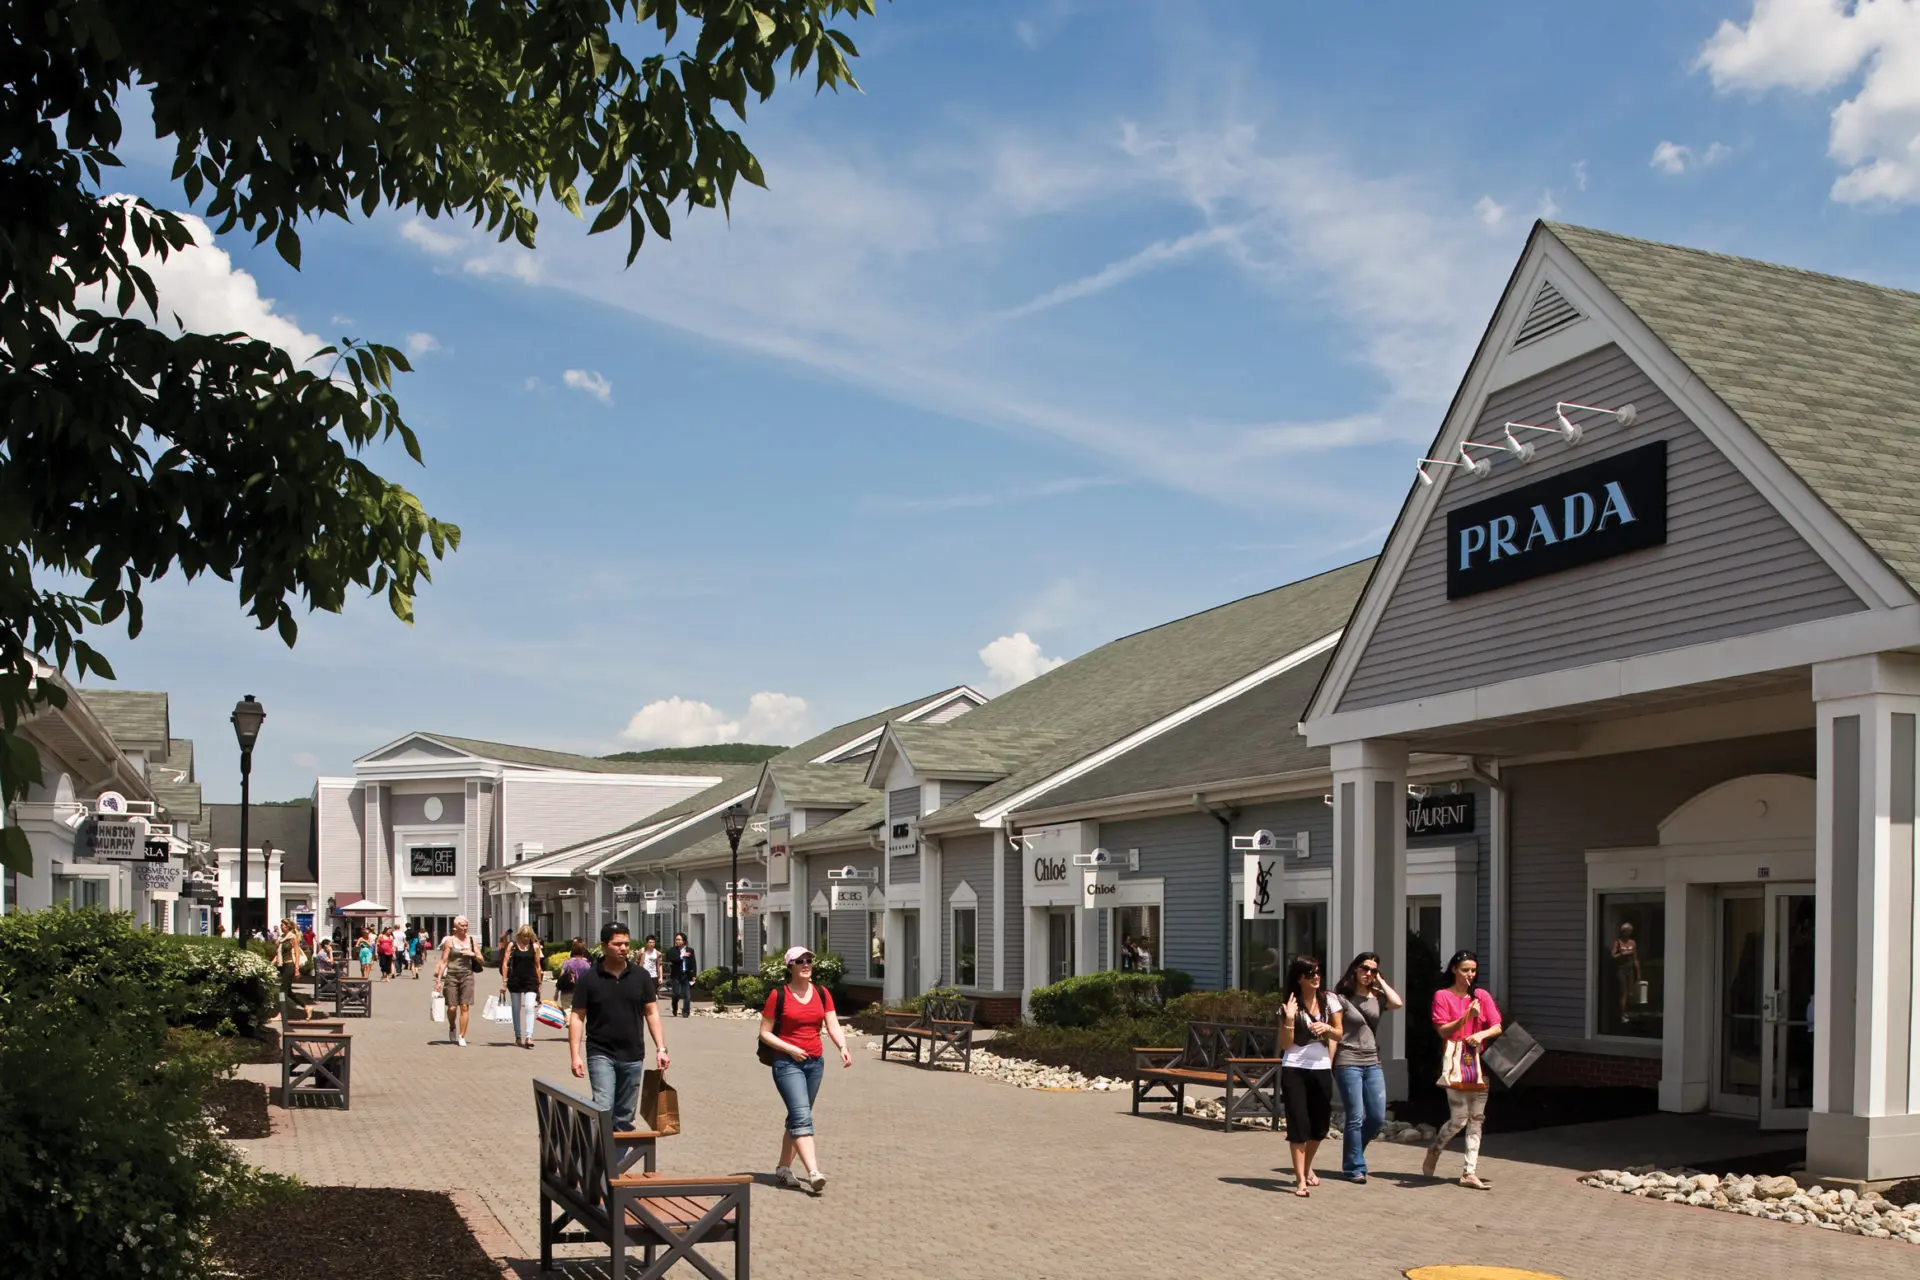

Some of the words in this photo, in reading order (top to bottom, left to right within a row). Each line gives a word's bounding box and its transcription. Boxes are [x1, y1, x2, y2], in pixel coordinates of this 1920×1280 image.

[1459, 481, 1638, 570] PRADA
[85, 824, 136, 838] JOHNSTON
[96, 837, 135, 850] MURPHY
[435, 850, 453, 861] OFF
[135, 866, 180, 876] COSMETICS
[435, 861, 453, 873] 5TH
[1034, 857, 1067, 881] Chloé
[139, 873, 176, 883] COMPANY
[145, 881, 169, 889] STORE
[1087, 884, 1116, 895] Chloé
[837, 892, 863, 901] BCBG
